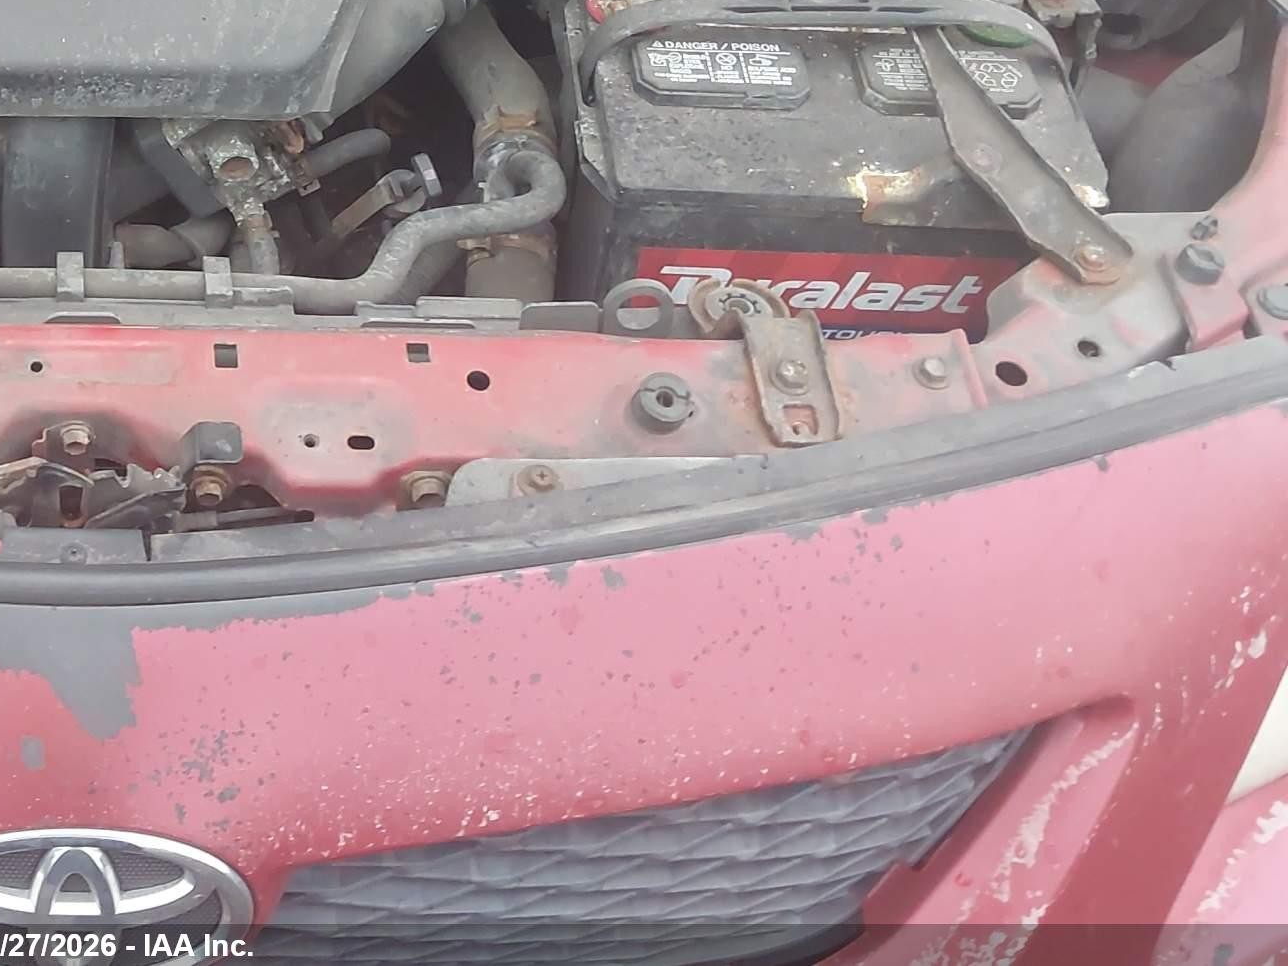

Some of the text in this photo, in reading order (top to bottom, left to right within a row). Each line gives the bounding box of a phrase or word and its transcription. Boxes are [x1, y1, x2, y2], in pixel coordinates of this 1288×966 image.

[664, 41, 780, 52] DANGER / POISON
[660, 265, 984, 314] Dralast
